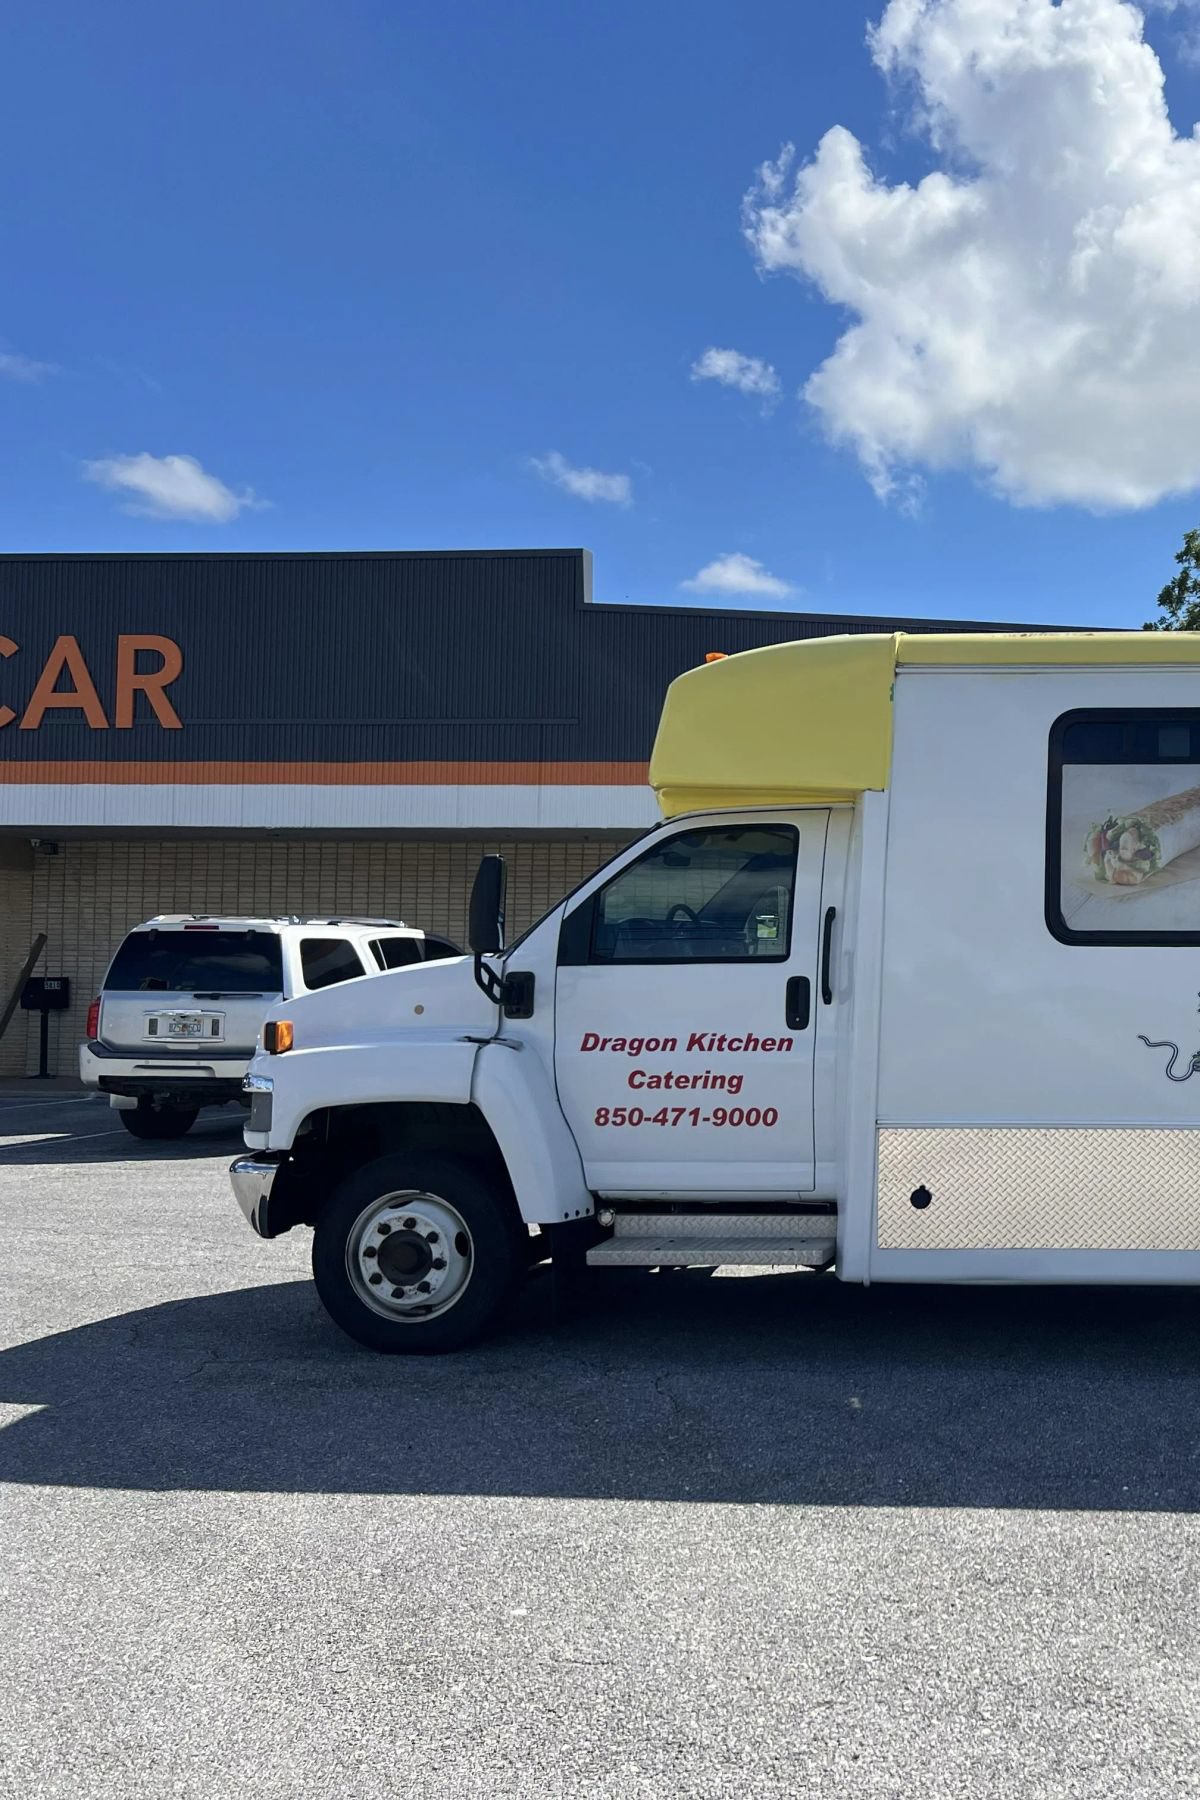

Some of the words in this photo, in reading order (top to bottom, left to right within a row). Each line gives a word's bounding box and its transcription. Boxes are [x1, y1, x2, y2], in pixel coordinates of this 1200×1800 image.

[0, 634, 183, 729] AR
[580, 1033, 677, 1056] Dragon
[686, 1033, 794, 1052] Kitchen
[627, 1070, 744, 1094] Catering
[594, 1107, 779, 1127] 850-471-9000
